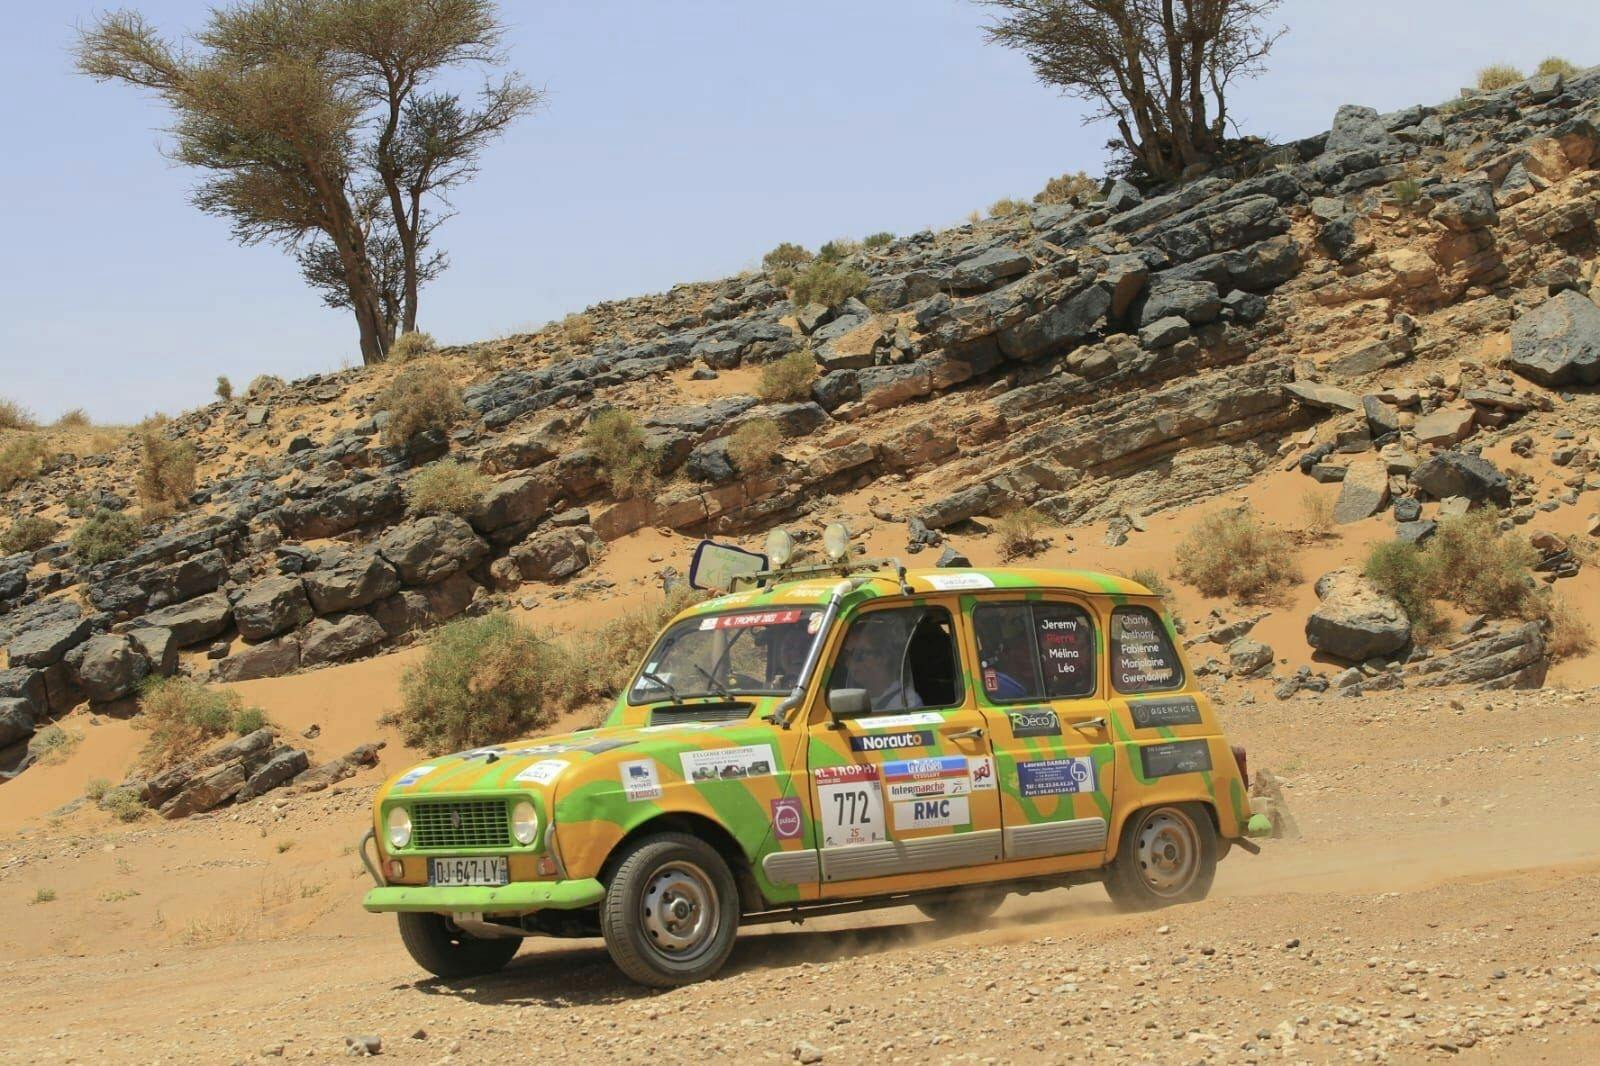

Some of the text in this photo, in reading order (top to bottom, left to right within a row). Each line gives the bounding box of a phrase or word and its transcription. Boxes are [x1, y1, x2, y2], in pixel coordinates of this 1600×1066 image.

[1041, 619, 1077, 631] Jeremy
[1121, 614, 1149, 626] Charly
[1120, 629, 1155, 641] Anthony
[1049, 648, 1079, 659] Mélina
[1121, 643, 1159, 655] Fabienne
[1057, 663, 1075, 673] Léo
[1121, 657, 1164, 669] Marjolaine
[1121, 672, 1170, 684] Gwendolyn
[862, 733, 922, 750] Norauto
[833, 763, 877, 777] TROPHY
[833, 790, 871, 826] 772
[914, 800, 950, 820] RMC
[436, 859, 498, 884] DJ-647-LY
